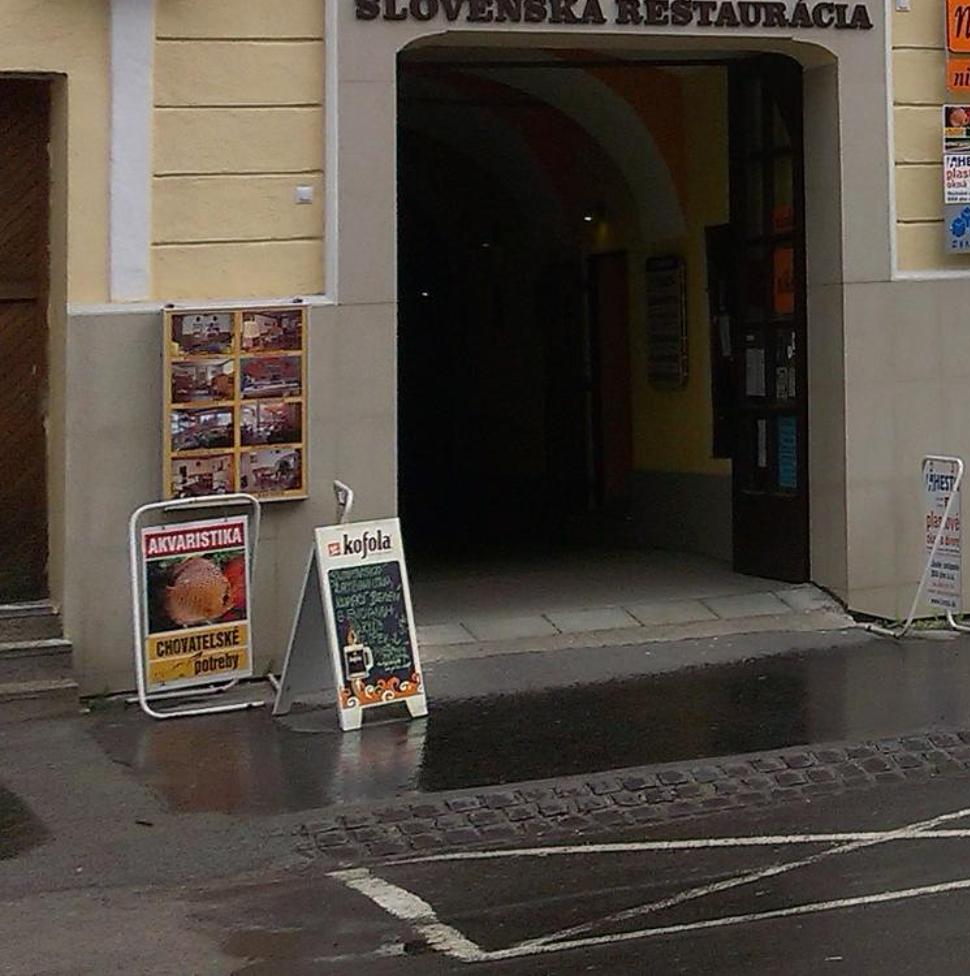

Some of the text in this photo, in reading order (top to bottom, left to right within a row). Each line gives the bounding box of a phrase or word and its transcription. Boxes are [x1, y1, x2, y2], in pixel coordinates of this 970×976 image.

[147, 527, 243, 554] AKVARISTIKA
[343, 529, 391, 559] kofola
[194, 653, 240, 675] potreby
